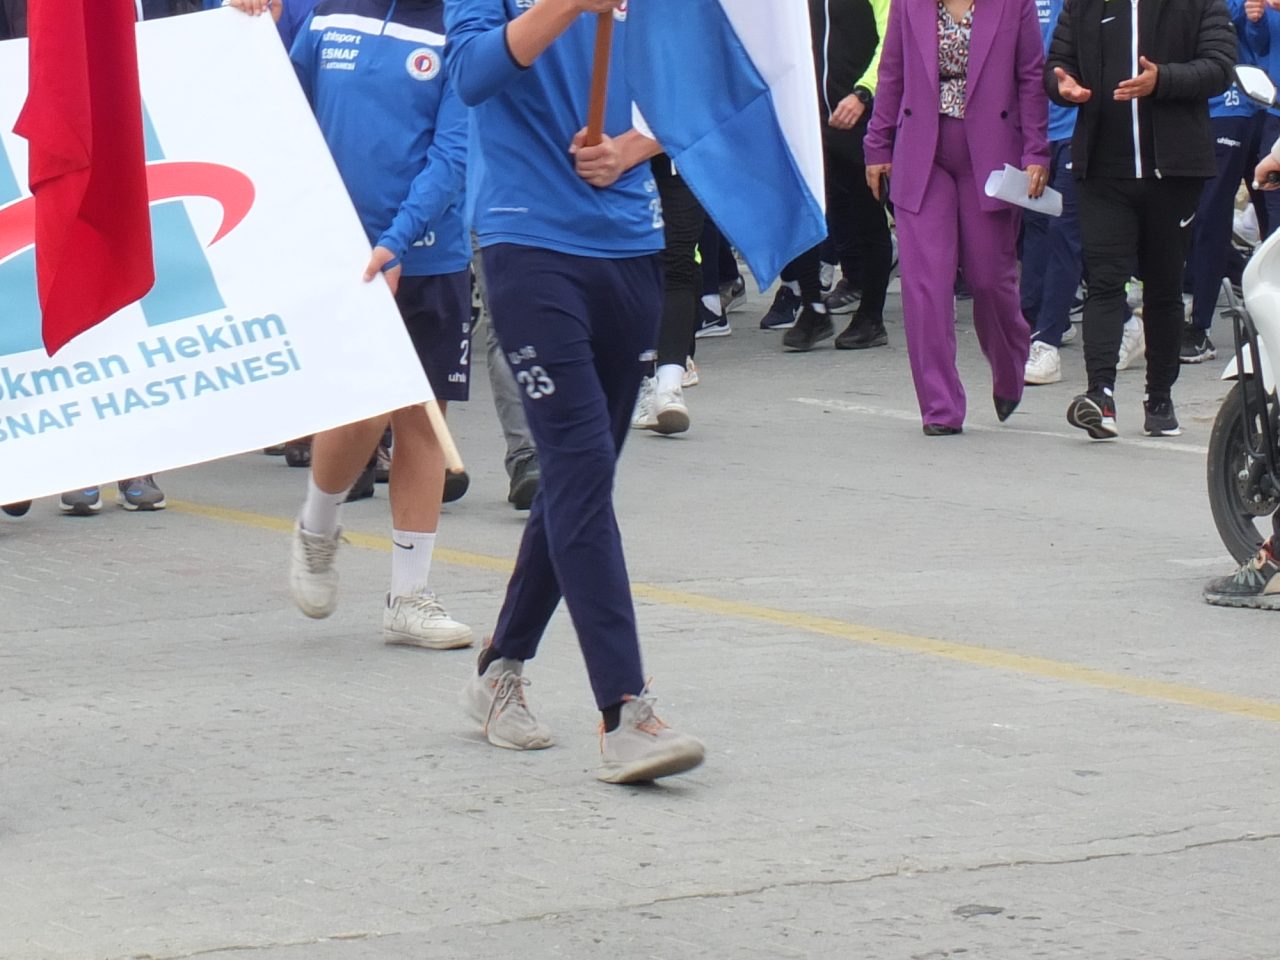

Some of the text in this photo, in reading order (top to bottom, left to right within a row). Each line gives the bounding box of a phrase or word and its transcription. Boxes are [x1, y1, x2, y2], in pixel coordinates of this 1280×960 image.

[321, 47, 359, 60] ESNAF
[137, 312, 287, 369] Hekim
[91, 341, 302, 420] HASTANESİ
[516, 365, 556, 400] 23
